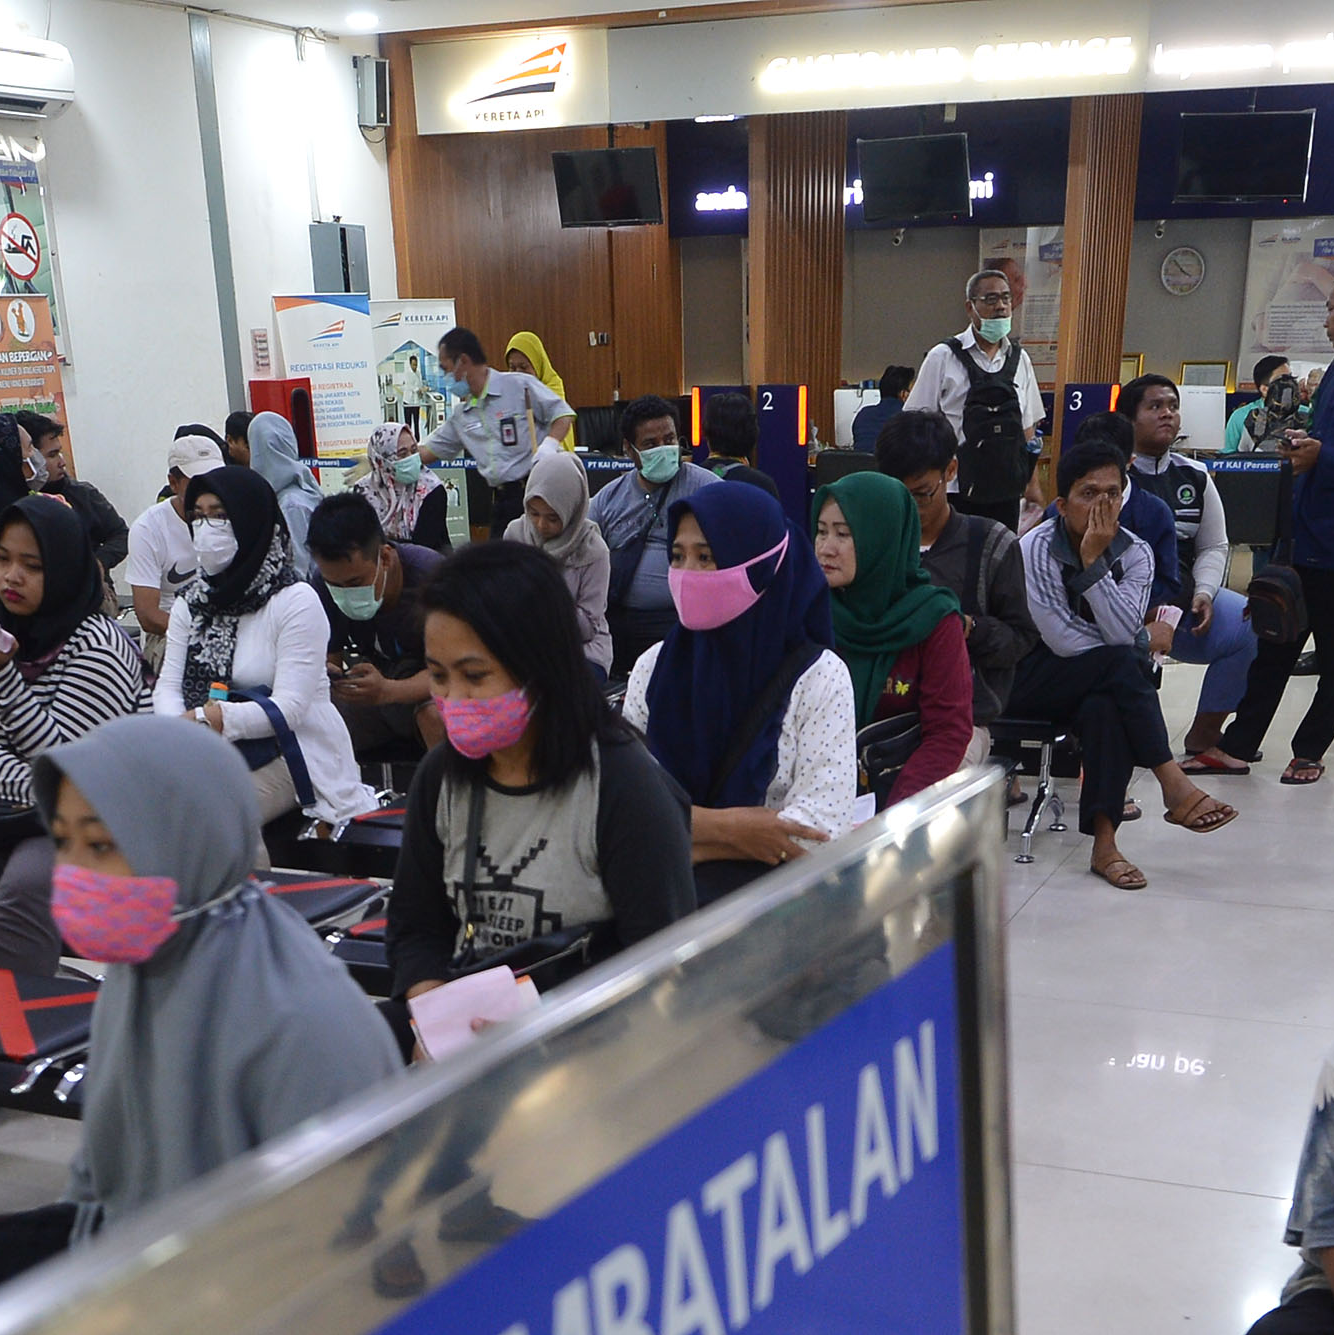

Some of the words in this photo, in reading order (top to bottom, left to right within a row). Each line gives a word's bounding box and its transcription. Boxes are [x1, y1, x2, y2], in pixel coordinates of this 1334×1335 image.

[475, 110, 520, 121] KERETA
[526, 109, 544, 119] API
[290, 362, 334, 373] REGISTRASI
[336, 360, 367, 370] REDUKSI
[761, 391, 774, 410] 2
[1069, 391, 1082, 411] 3
[1213, 461, 1224, 469] PT
[1226, 461, 1241, 469] KAI
